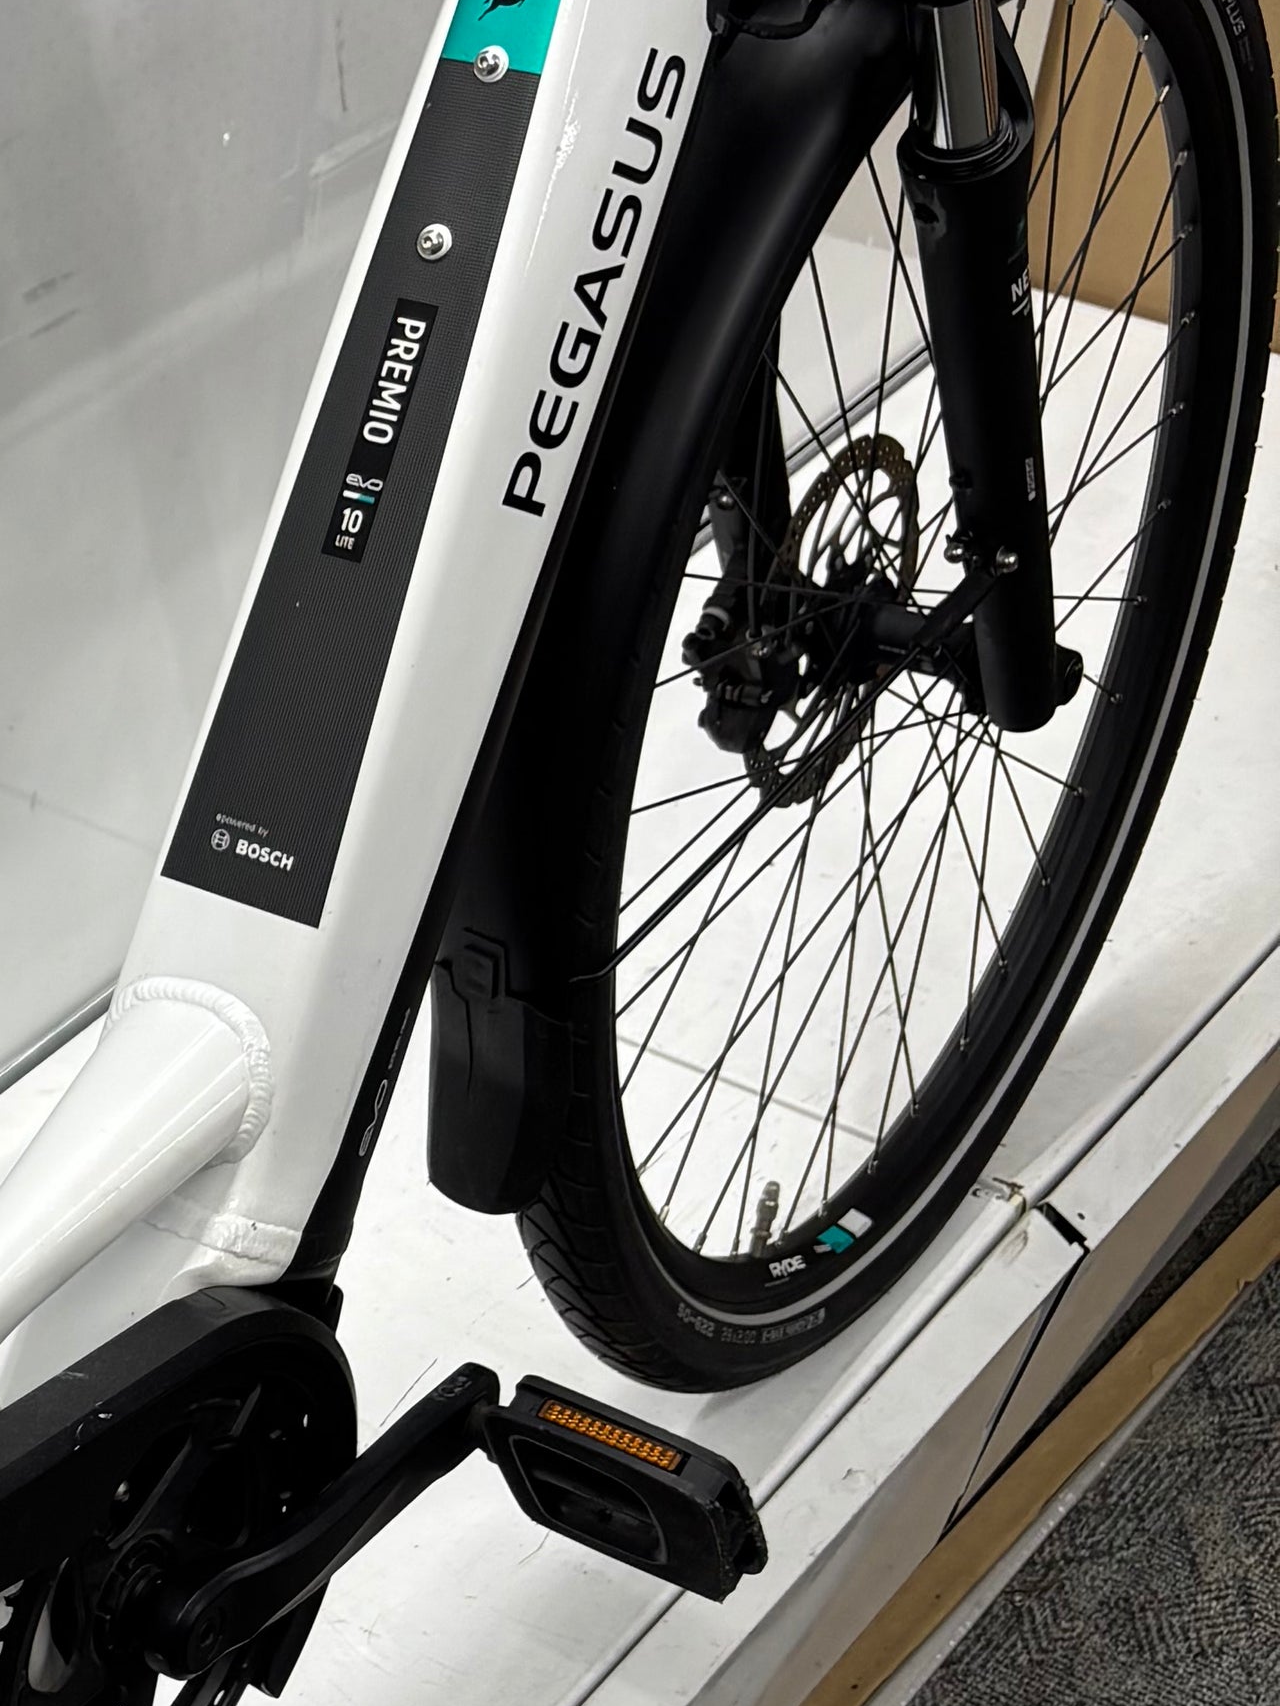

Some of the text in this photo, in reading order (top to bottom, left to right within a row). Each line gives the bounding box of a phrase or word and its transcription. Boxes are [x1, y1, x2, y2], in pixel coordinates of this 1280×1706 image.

[502, 47, 687, 518] PEGASUS
[362, 317, 427, 445] PREMIO
[341, 507, 363, 534] 10
[335, 534, 355, 550] LITE
[235, 838, 294, 871] BOSCH
[768, 1255, 807, 1278] RYDE
